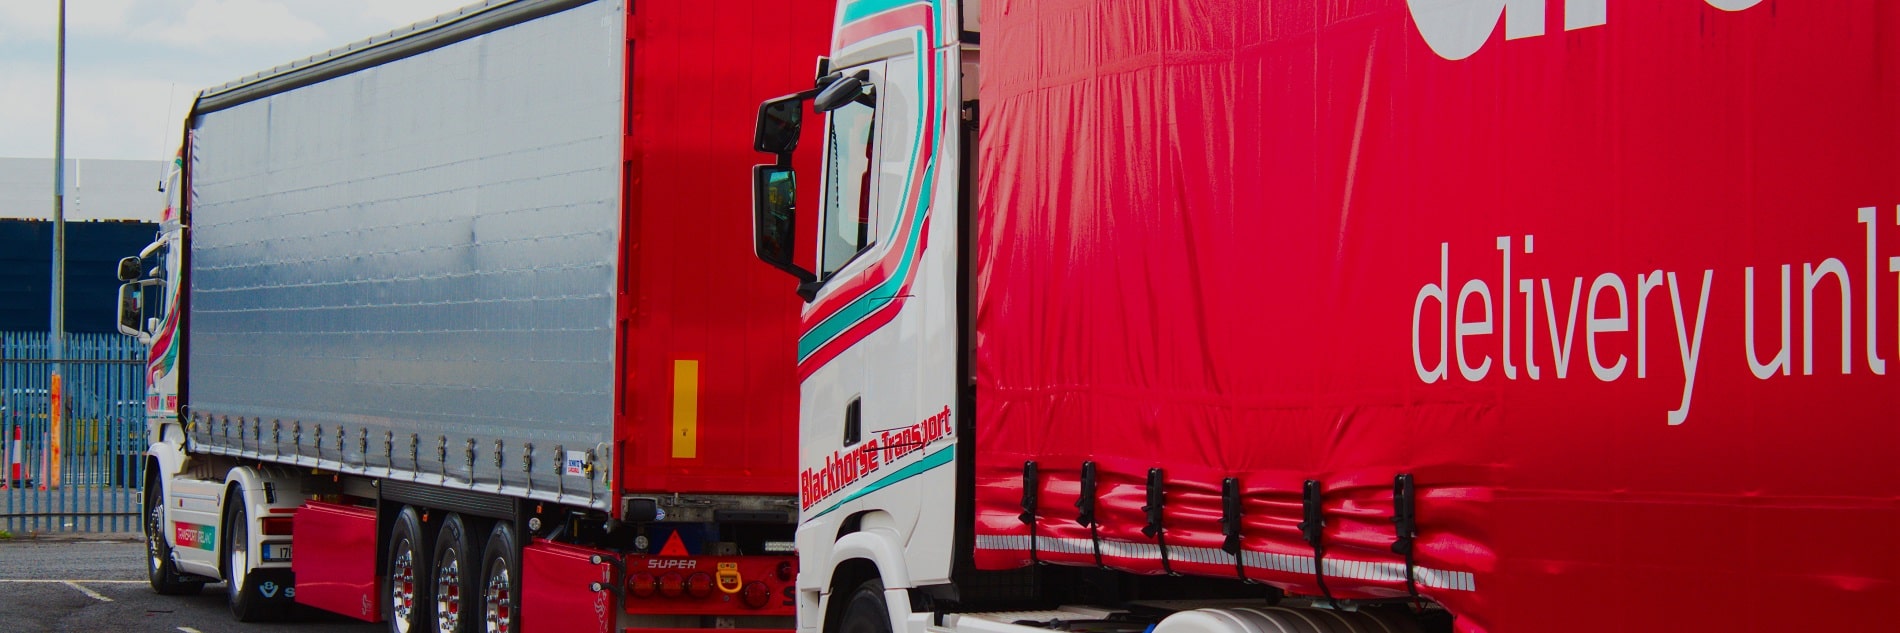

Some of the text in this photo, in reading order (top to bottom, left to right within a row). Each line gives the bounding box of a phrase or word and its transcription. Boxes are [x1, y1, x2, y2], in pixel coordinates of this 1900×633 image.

[1411, 234, 1714, 426] delivery
[801, 404, 953, 512] Blackhorse Transport
[647, 559, 697, 569] SUPER
